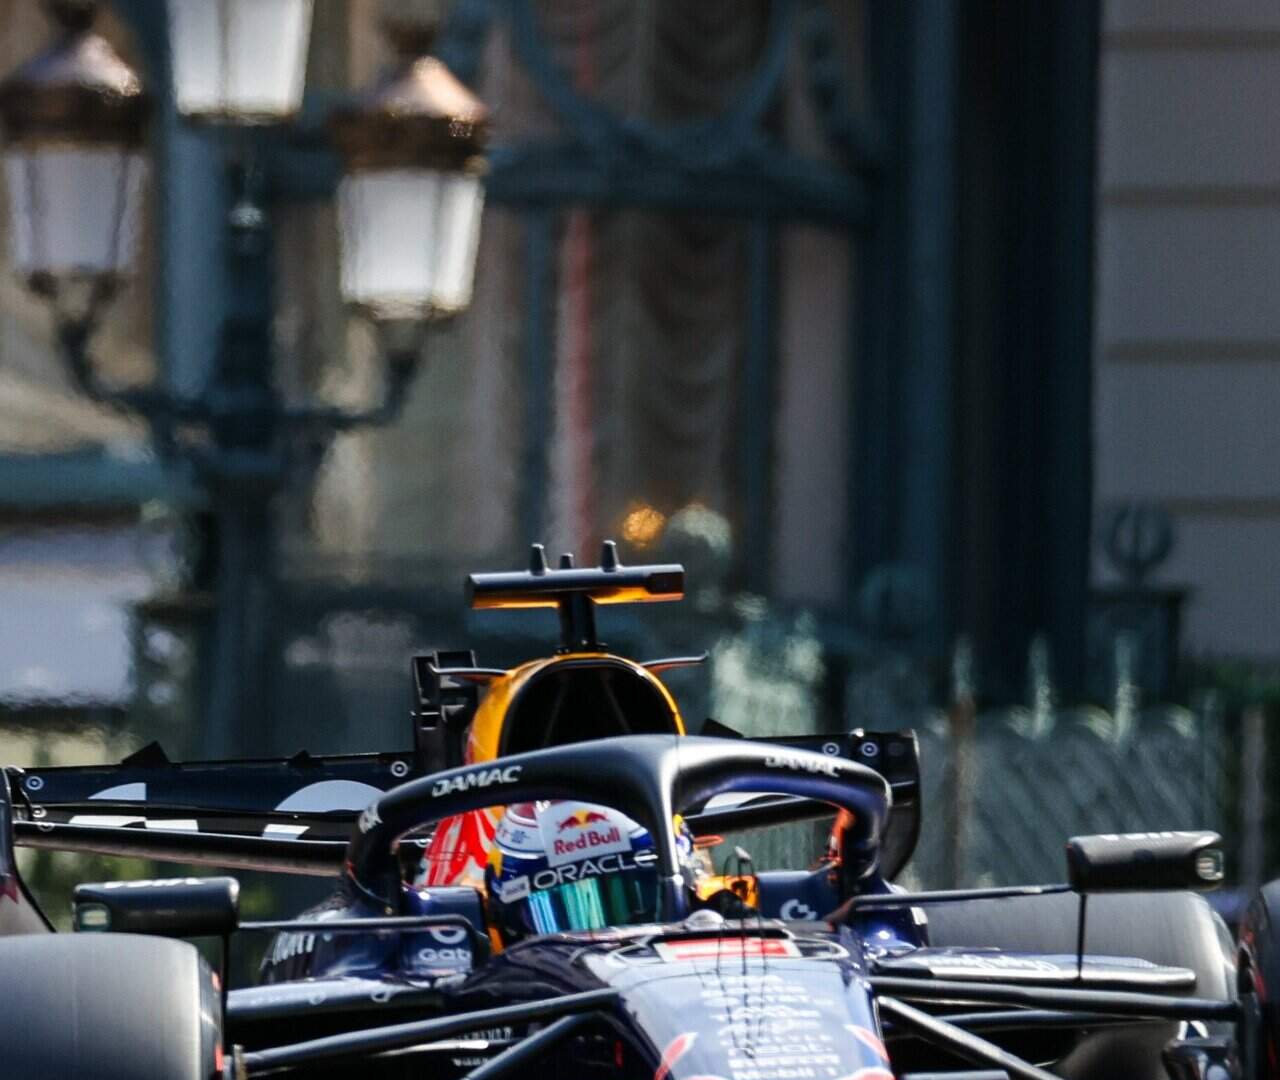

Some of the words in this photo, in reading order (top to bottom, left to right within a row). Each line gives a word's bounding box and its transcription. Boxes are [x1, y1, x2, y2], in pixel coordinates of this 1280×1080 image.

[431, 765, 523, 798] DAMAC
[553, 834, 588, 857] Red
[589, 827, 622, 848] Bull
[533, 849, 660, 890] ORACLE
